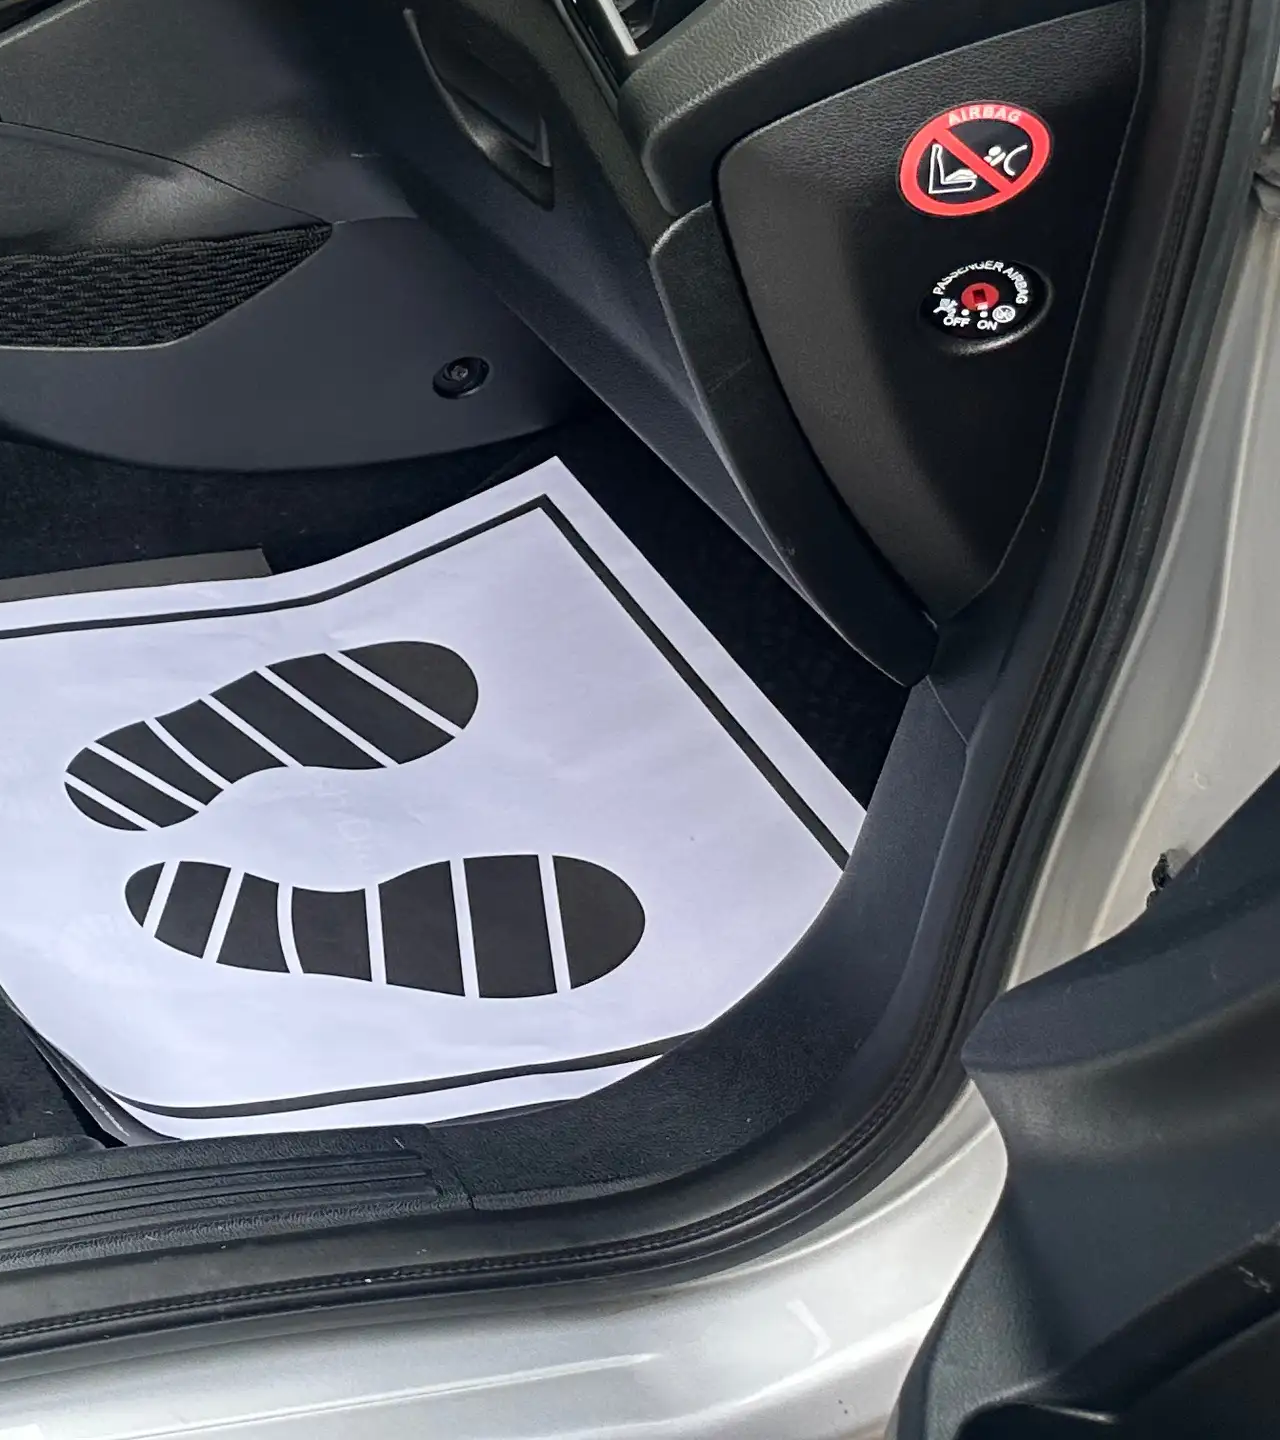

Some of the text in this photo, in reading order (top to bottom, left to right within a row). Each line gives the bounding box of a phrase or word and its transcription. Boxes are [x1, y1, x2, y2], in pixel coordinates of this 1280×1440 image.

[948, 105, 1022, 127] AIRBAG
[1002, 266, 1029, 305] AIRBAG
[942, 316, 998, 331] OFF ON
